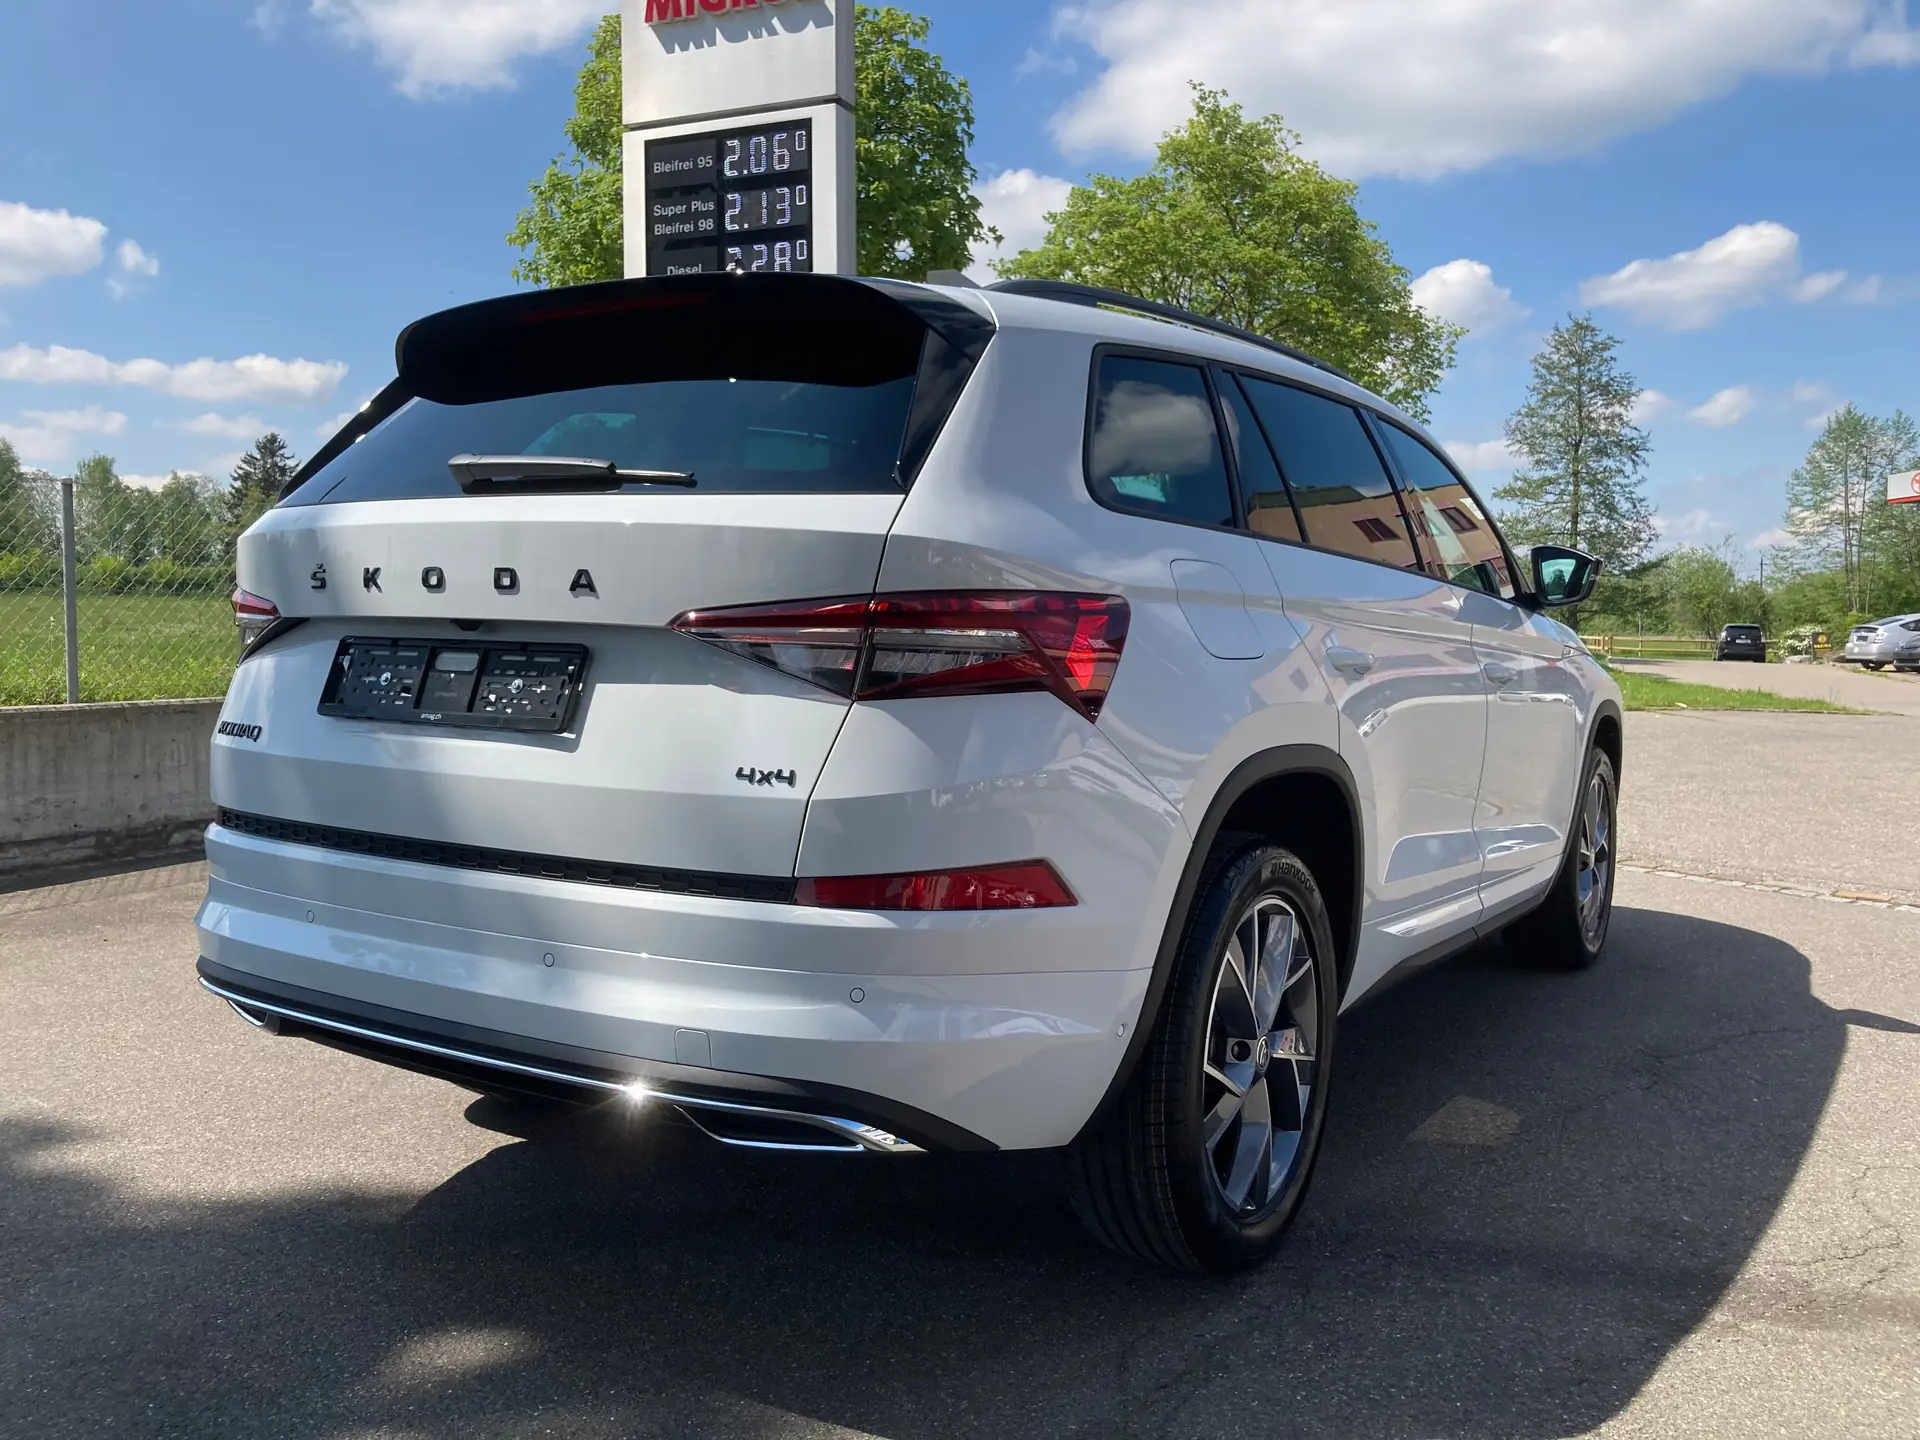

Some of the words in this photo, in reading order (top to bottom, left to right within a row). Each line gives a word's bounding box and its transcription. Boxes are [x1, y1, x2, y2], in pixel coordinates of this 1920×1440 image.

[653, 158, 693, 173] Bleifrei
[697, 156, 713, 168] 95
[653, 204, 687, 217] Super
[691, 201, 715, 212] Plus
[654, 221, 694, 235] Bleifrei
[698, 219, 714, 231] 98
[667, 263, 702, 276] Diesel
[735, 766, 797, 788] 4x4
